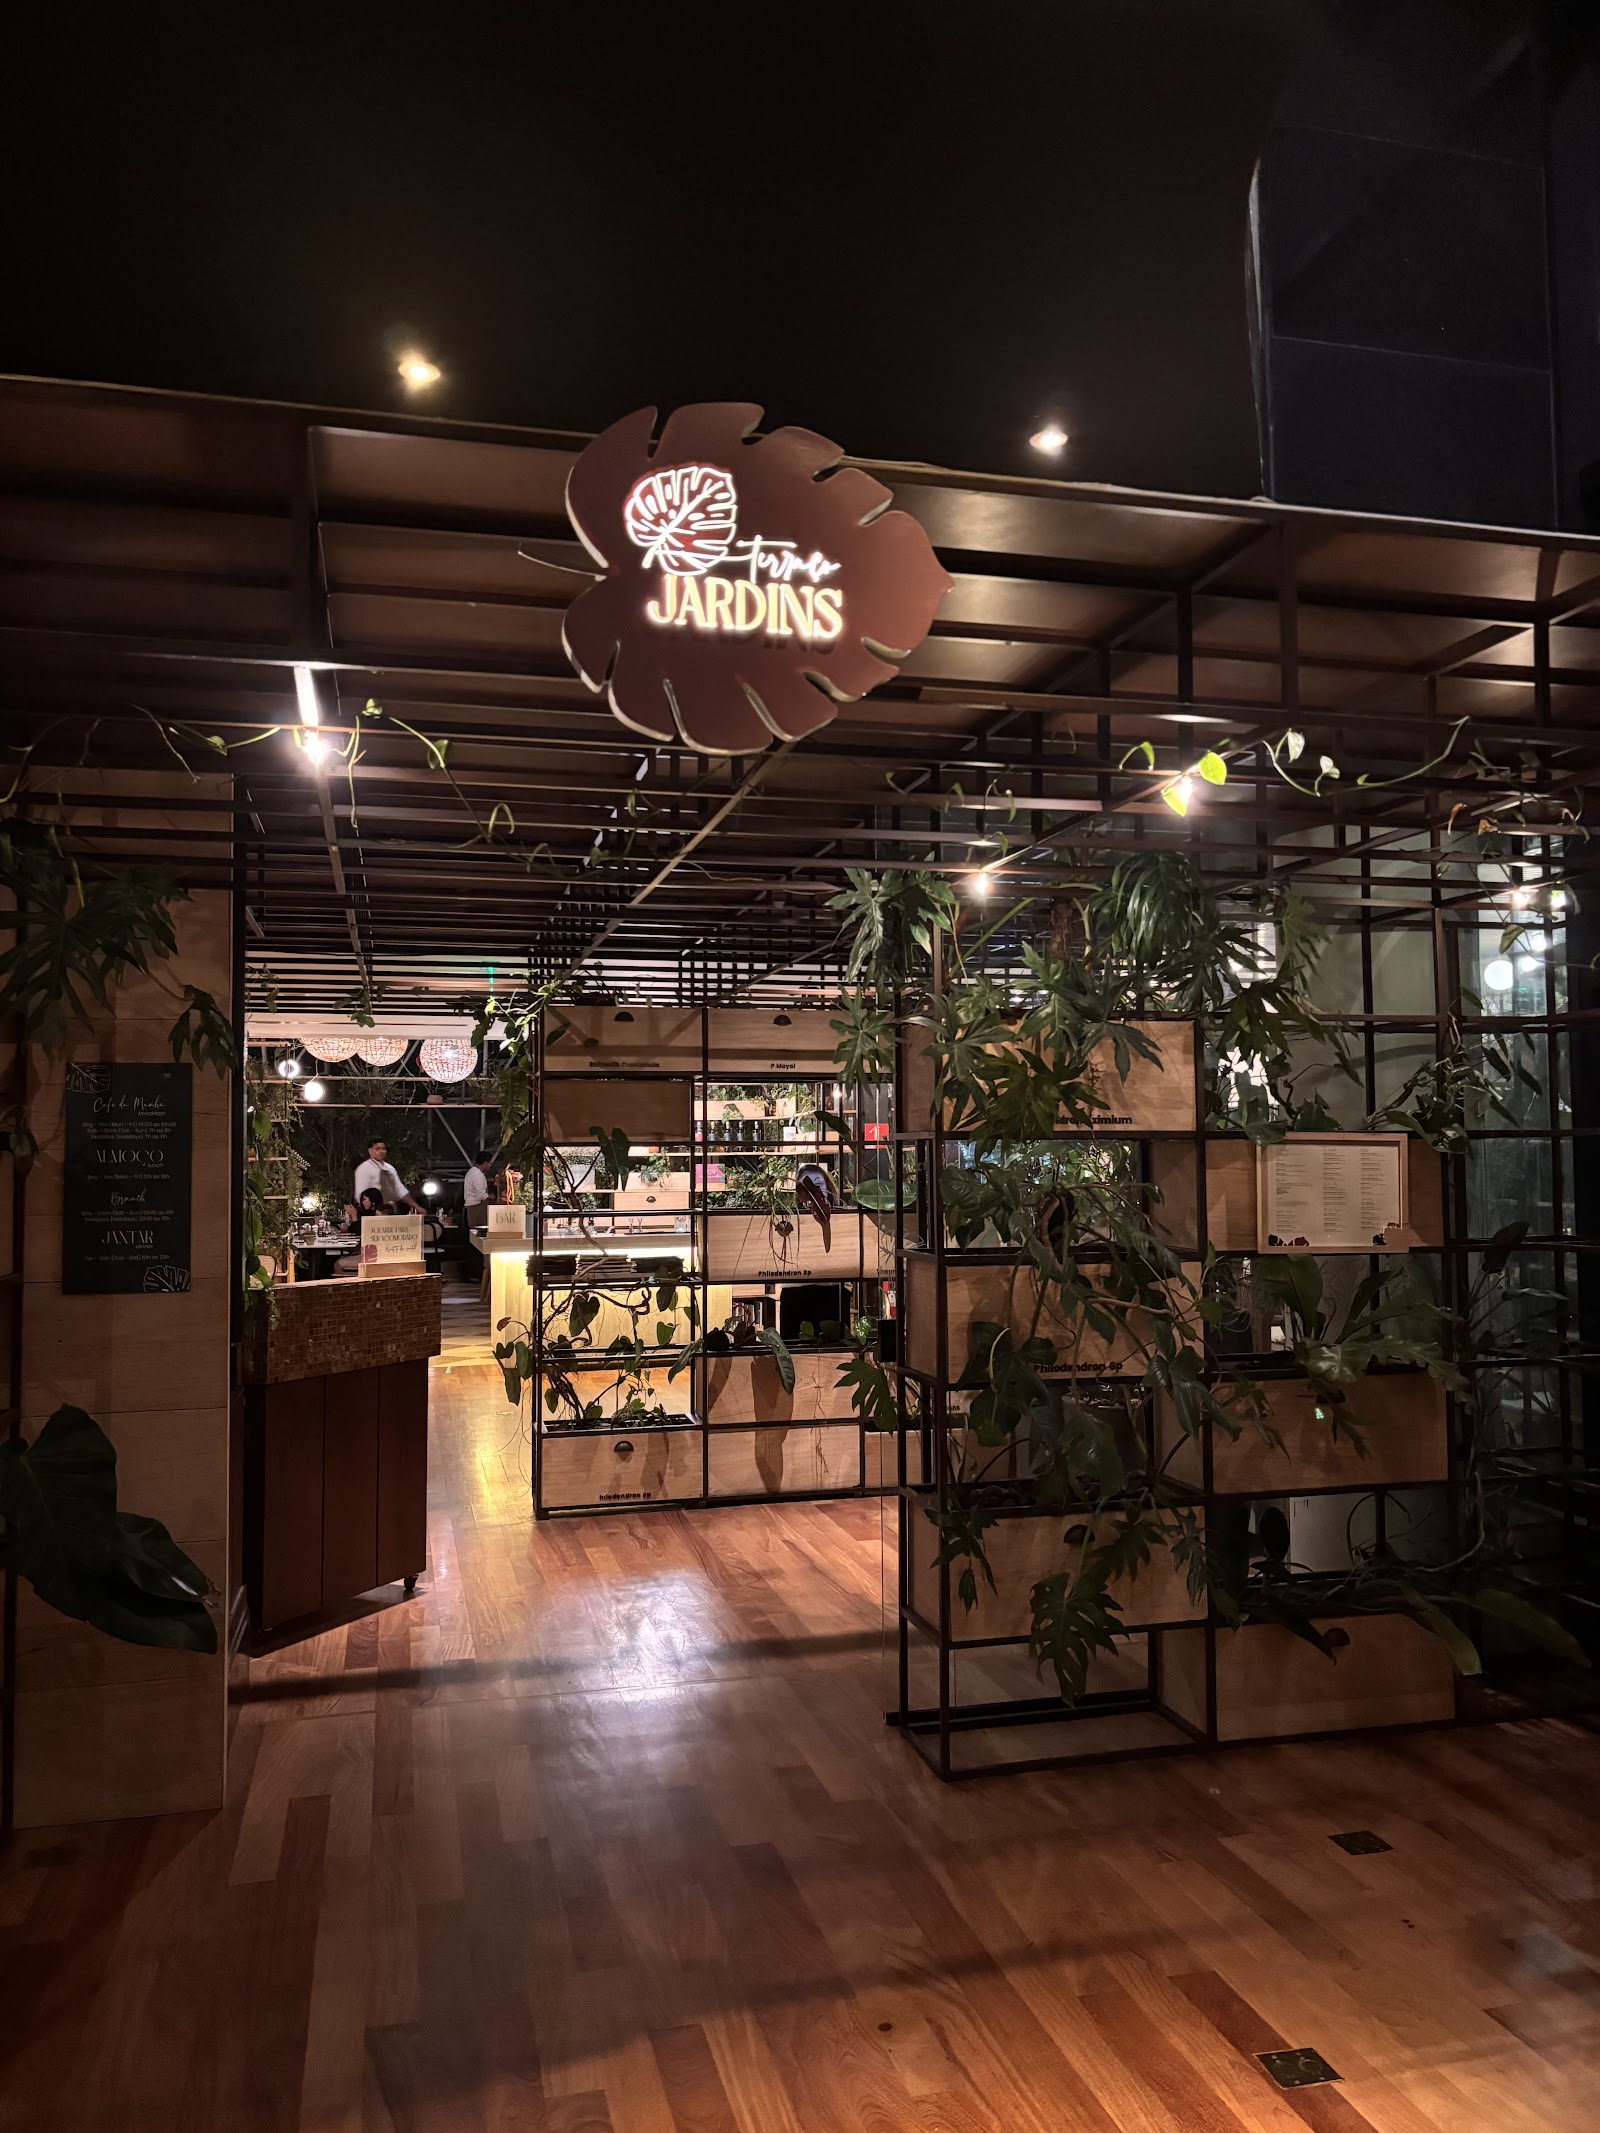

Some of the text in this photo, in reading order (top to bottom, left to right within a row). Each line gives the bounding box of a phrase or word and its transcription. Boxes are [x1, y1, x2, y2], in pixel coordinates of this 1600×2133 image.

[646, 573, 844, 639] JARDINS
[110, 1188, 147, 1206] Brunch
[496, 1212, 516, 1224] BAR
[101, 1230, 153, 1244] JANTAR
